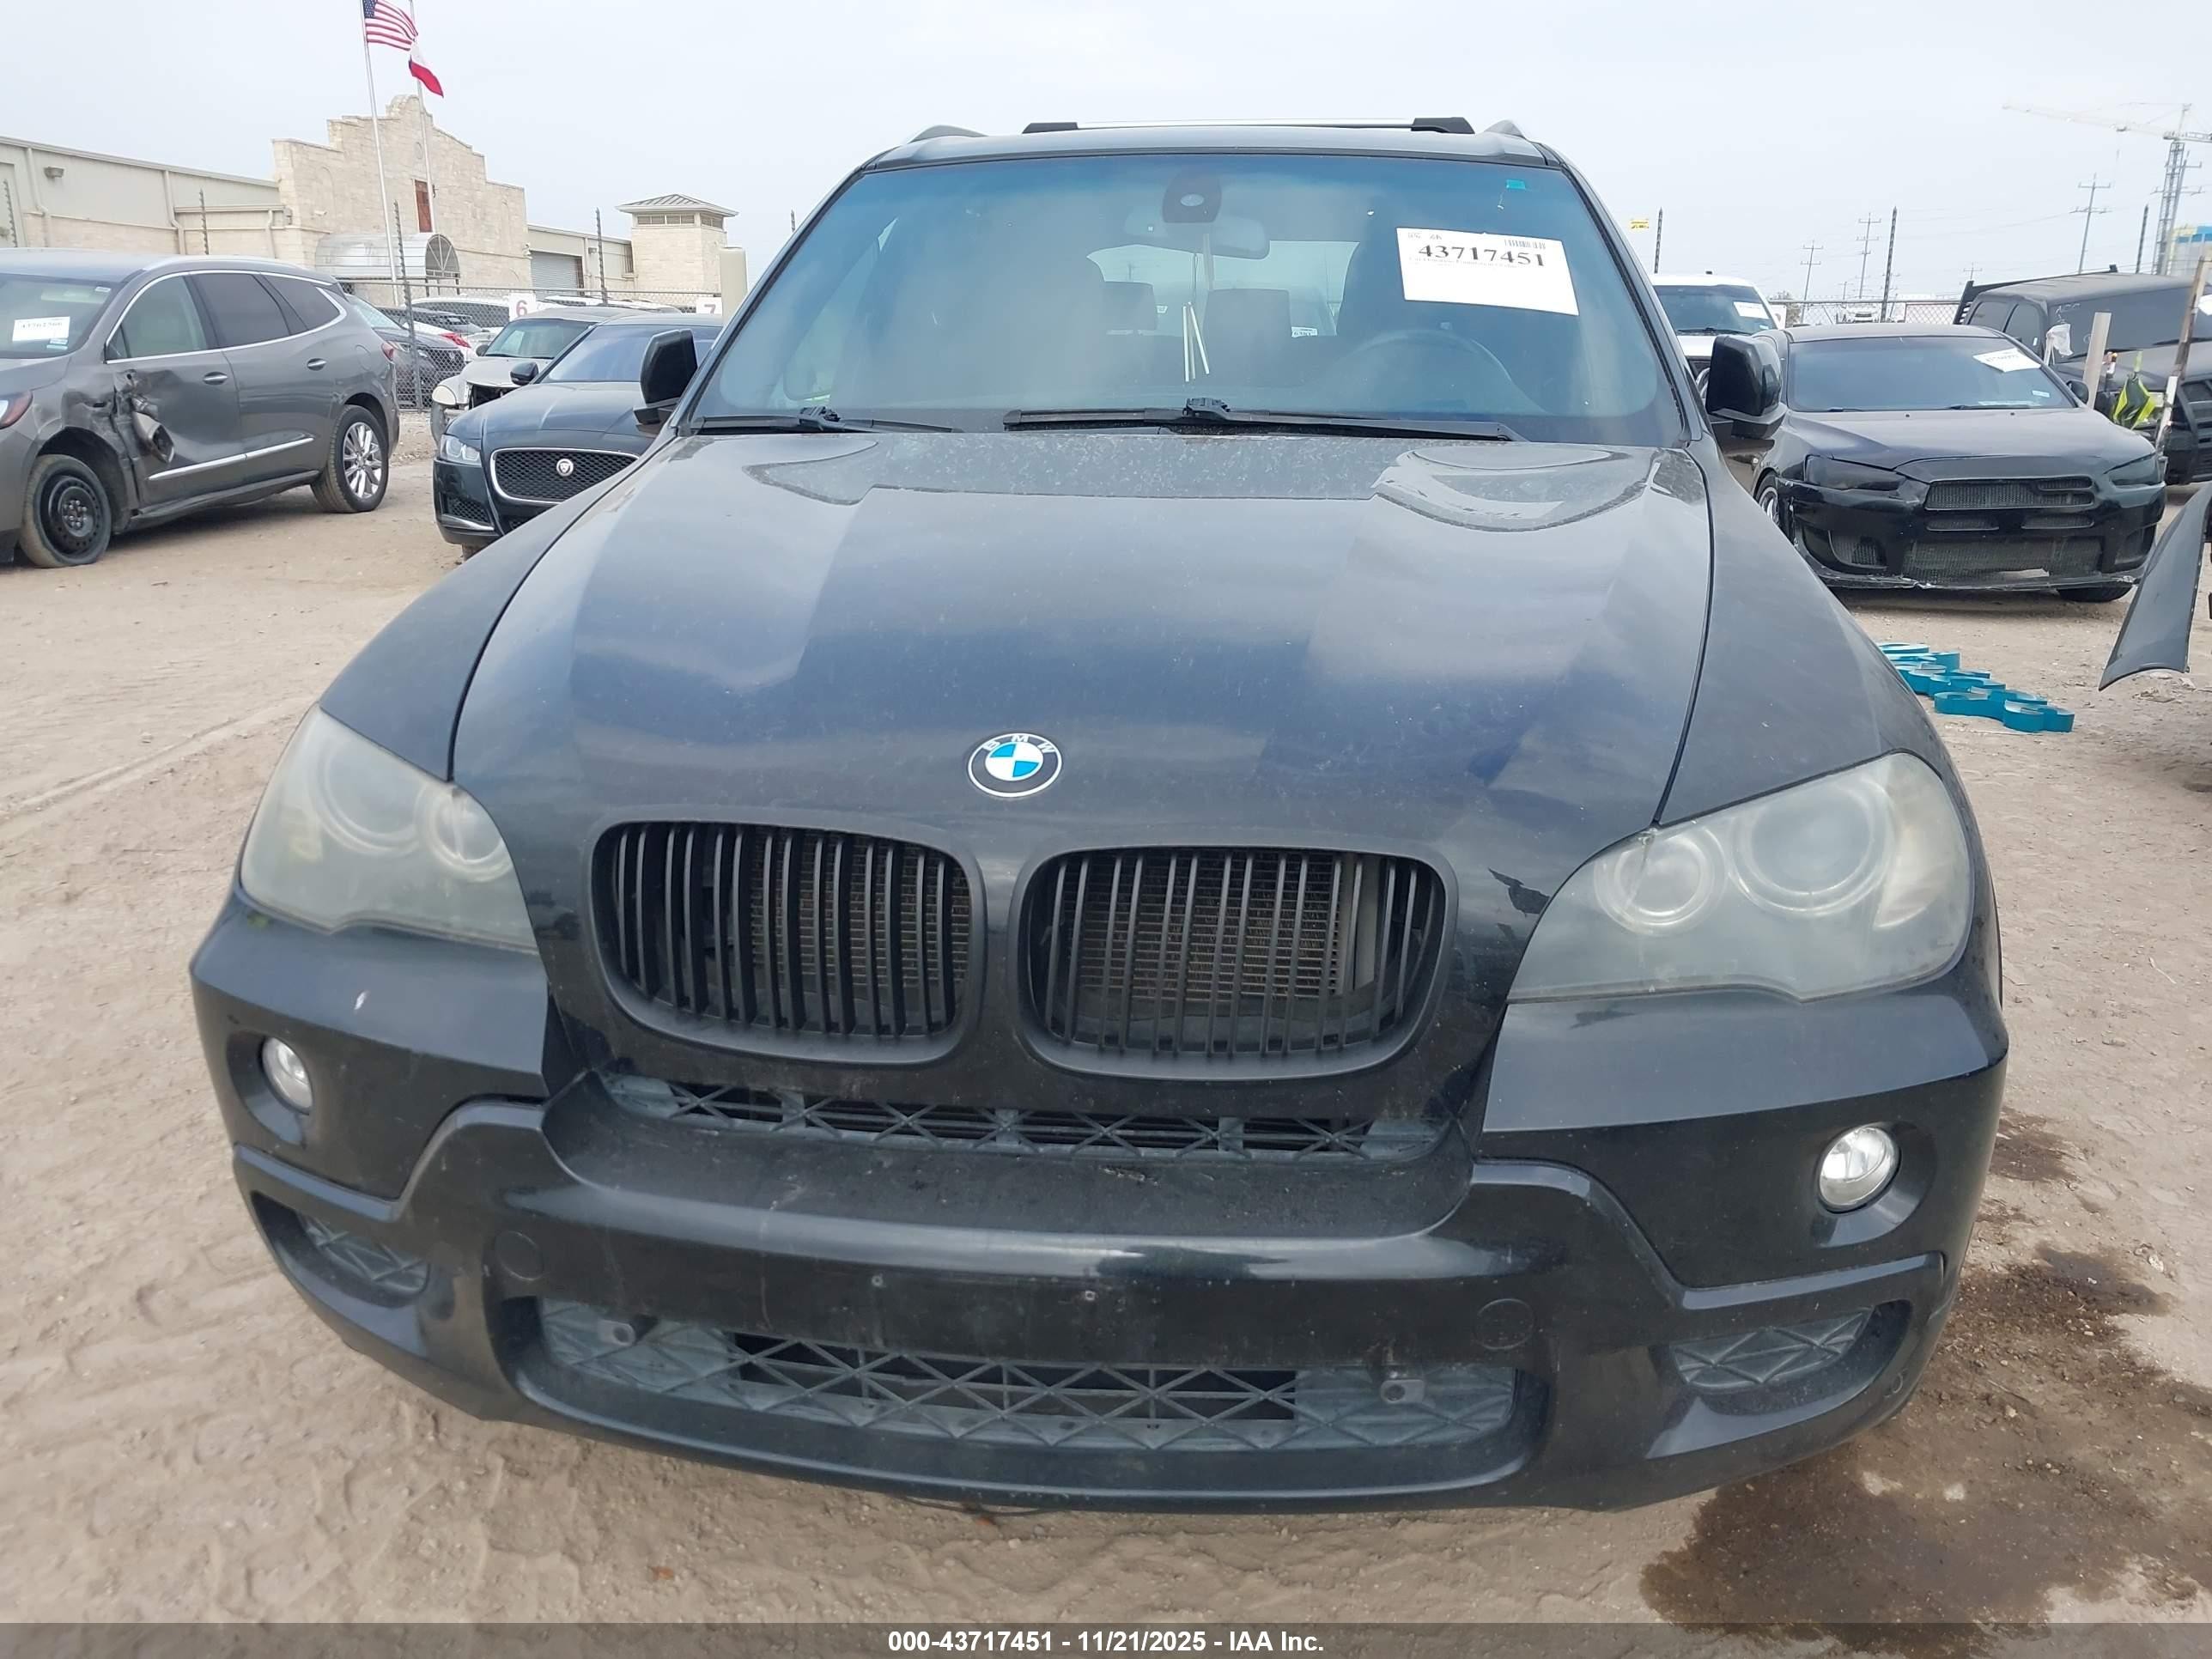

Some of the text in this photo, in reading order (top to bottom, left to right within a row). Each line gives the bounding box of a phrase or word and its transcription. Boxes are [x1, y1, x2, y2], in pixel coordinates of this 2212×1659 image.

[1418, 244, 1546, 267] 43717451
[515, 300, 528, 317] 6
[981, 734, 1056, 753] BMW
